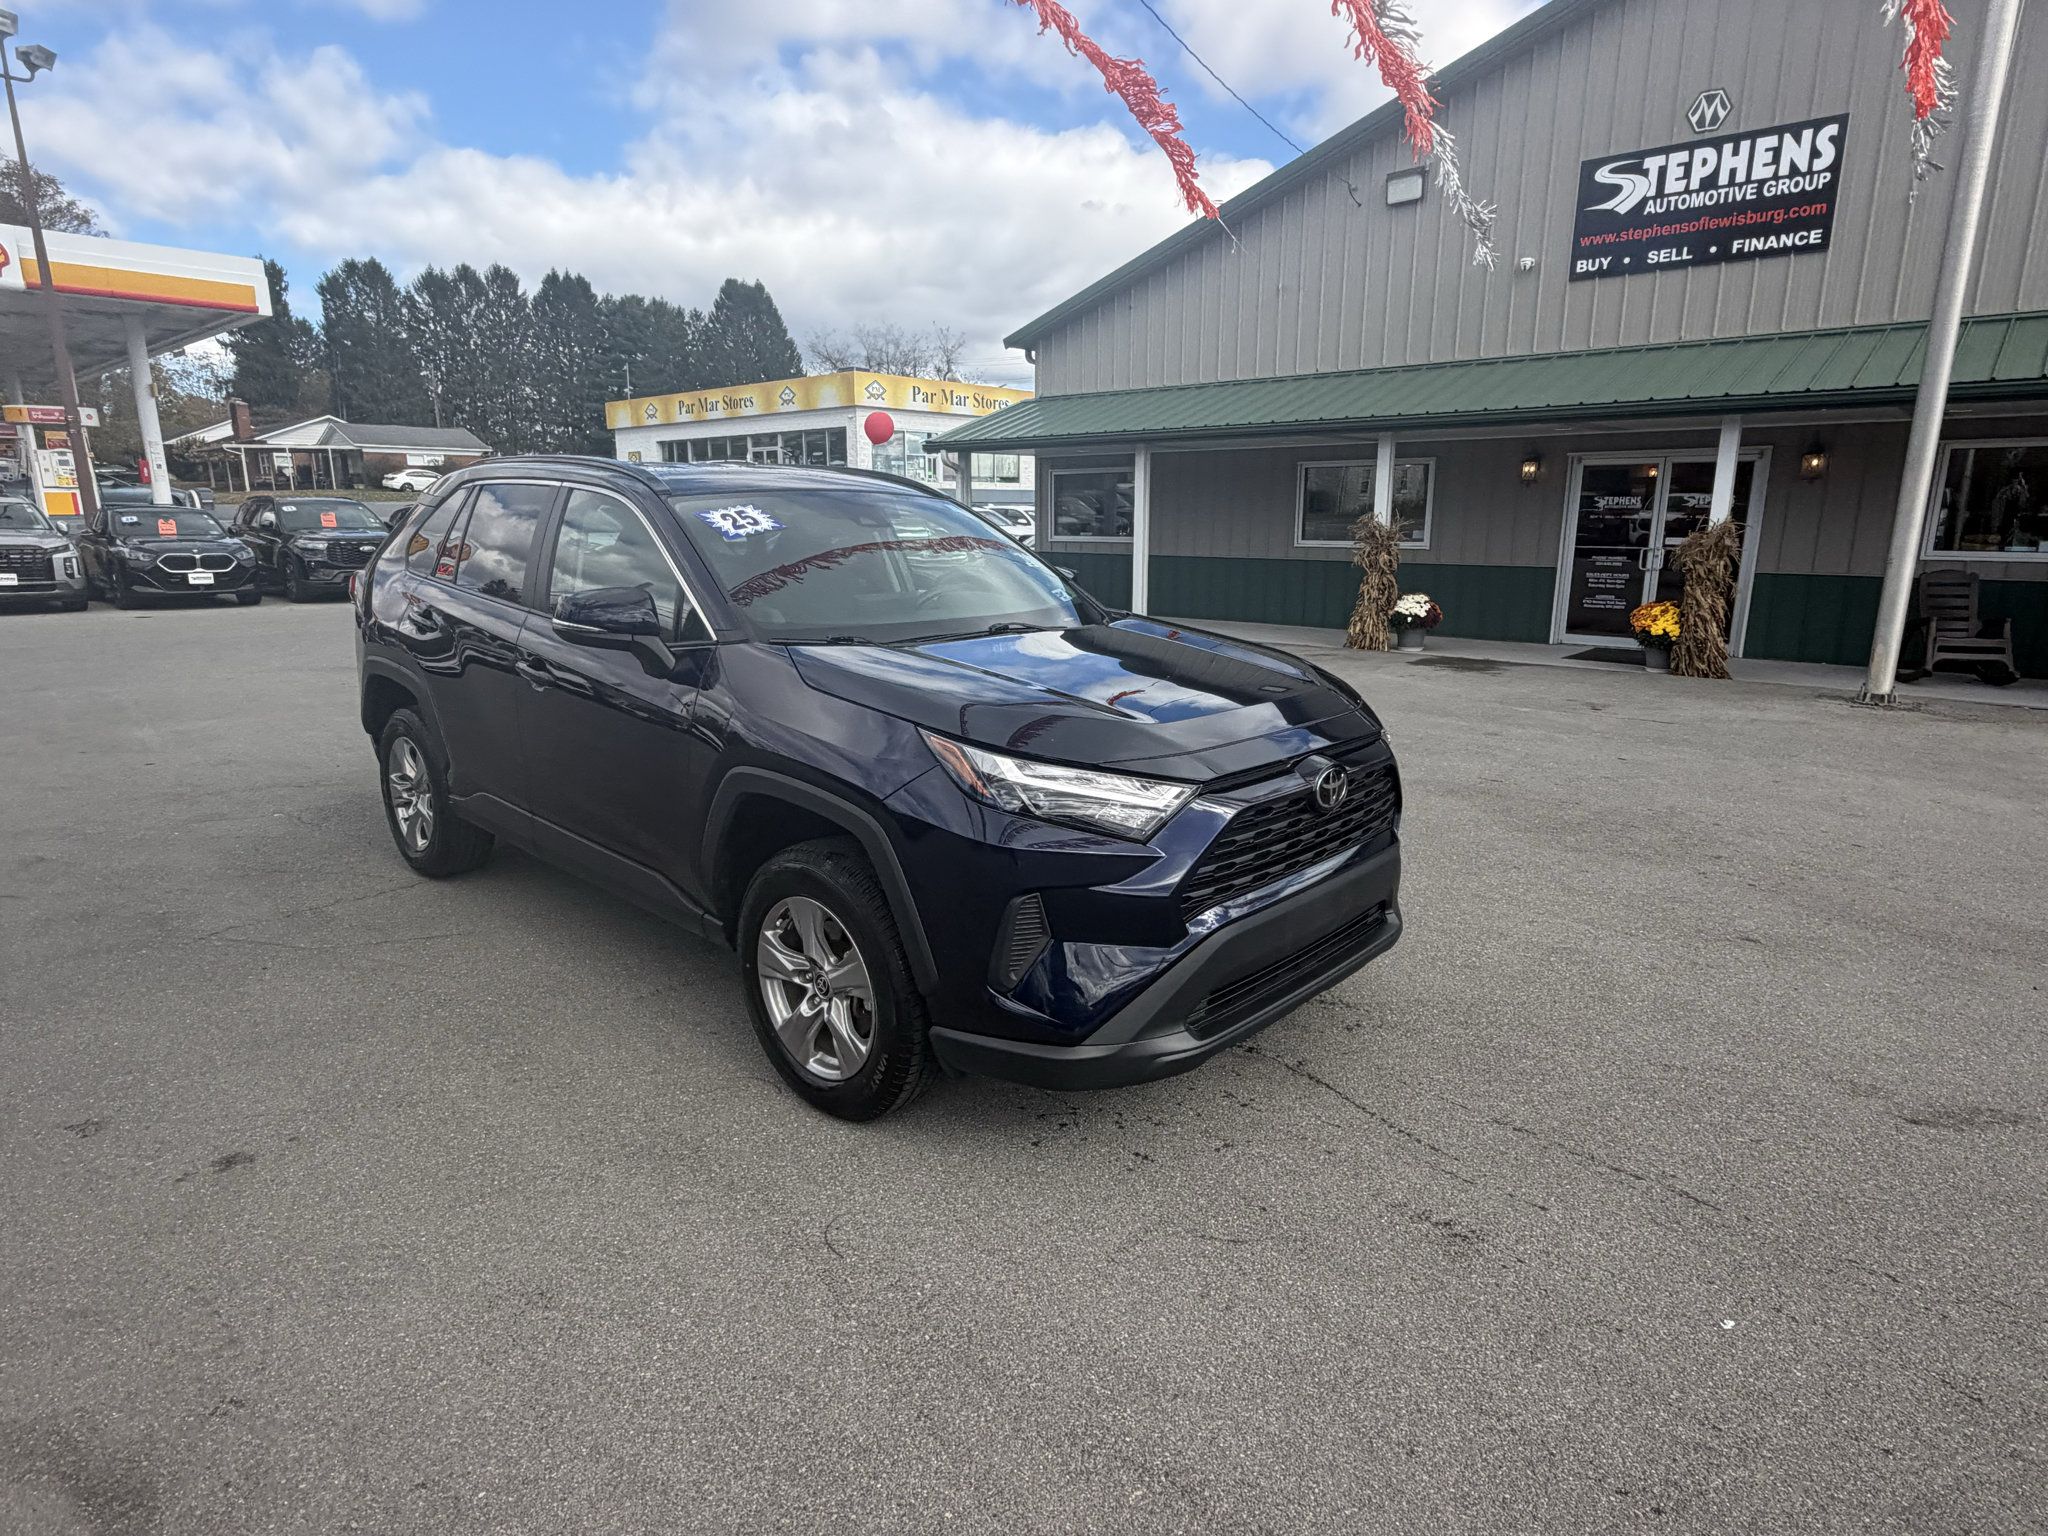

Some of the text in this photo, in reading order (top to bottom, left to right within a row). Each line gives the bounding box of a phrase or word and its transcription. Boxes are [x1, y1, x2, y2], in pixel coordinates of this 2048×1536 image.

[1584, 124, 1839, 214] STEPHENS
[1643, 172, 1831, 215] AUTOMOTIVE GROUP
[1580, 203, 1827, 246] www.stephensoflewisburg.com
[1576, 229, 1823, 273] BUY SELL FINANCE
[678, 395, 754, 415] Par Mar Stores
[912, 385, 1011, 410] Par Mar Stores
[1594, 496, 1642, 508] STEPHENS
[720, 510, 760, 530] 25
